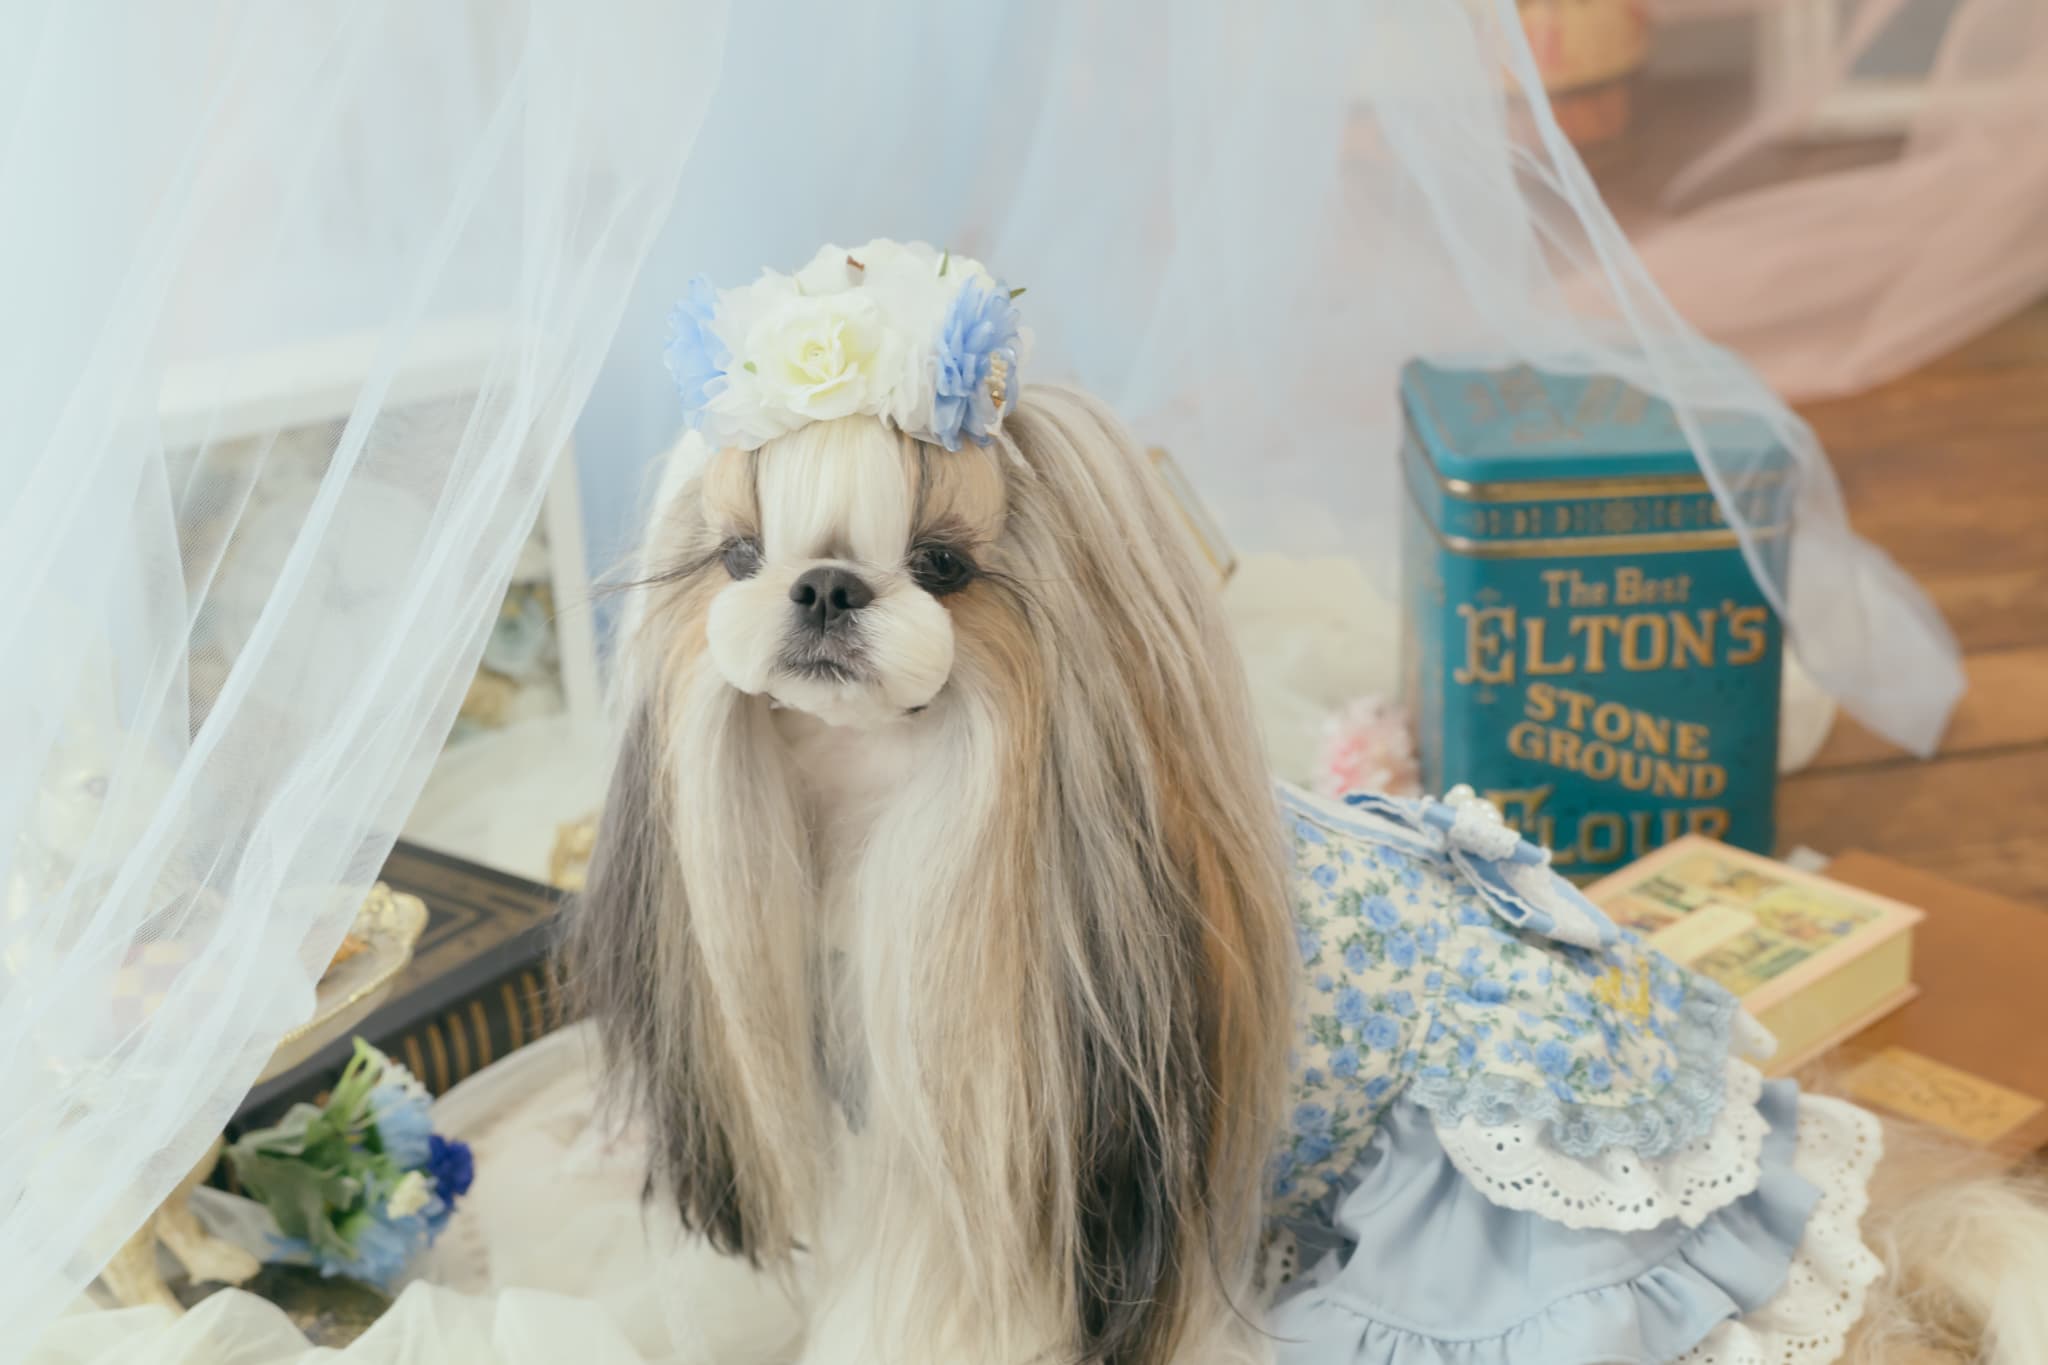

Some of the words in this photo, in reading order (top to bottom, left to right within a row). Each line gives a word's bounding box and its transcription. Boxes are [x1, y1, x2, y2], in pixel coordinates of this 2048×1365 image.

[1541, 569, 1608, 608] The
[1614, 567, 1691, 605] Best
[1453, 599, 1767, 685] ELTON'S
[1507, 721, 1728, 799] GROUND
[1524, 682, 1710, 761] STONE
